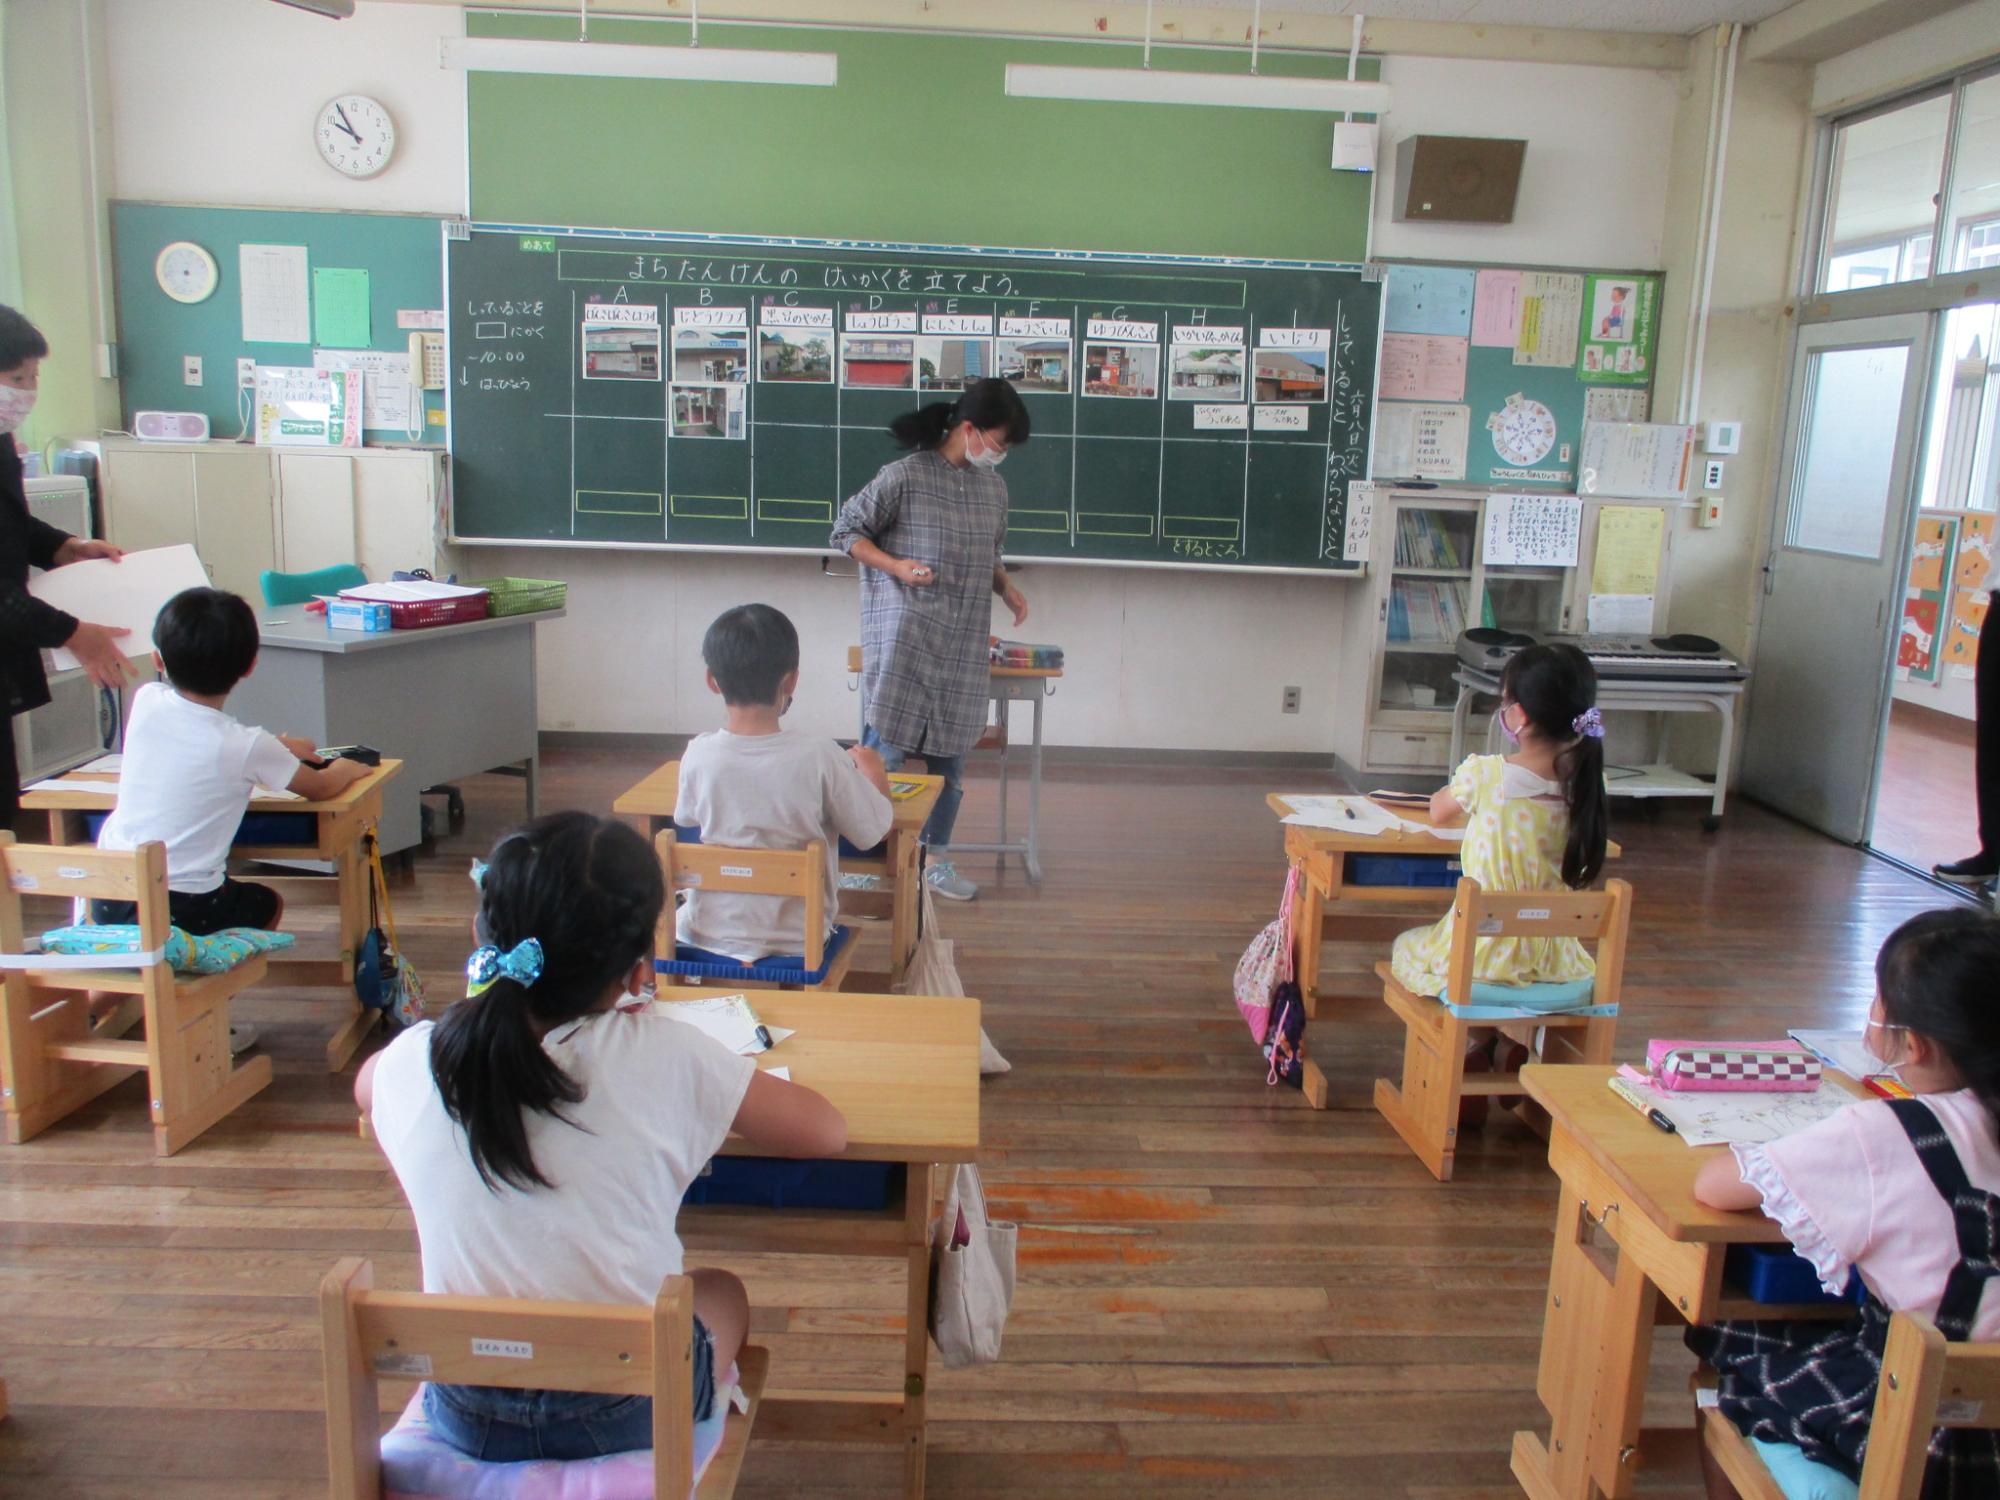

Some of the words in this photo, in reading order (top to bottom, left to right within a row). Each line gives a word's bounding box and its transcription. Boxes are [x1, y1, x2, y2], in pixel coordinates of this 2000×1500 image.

[350, 102, 358, 112] 12
[327, 116, 336, 125] 10
[376, 118, 380, 128] 2
[324, 130, 330, 138] 9
[381, 132, 386, 142] 3
[328, 144, 336, 153] 8
[376, 146, 382, 156] 4
[340, 154, 345, 164] 7
[352, 160, 359, 168] 6
[366, 156, 372, 166] 5
[523, 240, 551, 251] めあて
[629, 255, 798, 284] まちたんけんの
[613, 285, 629, 304] A
[700, 288, 713, 306] B
[784, 291, 799, 307] C
[870, 295, 883, 311] D
[946, 298, 959, 314] E
[1028, 301, 1041, 318] F
[852, 313, 912, 329] しょうぼうこ
[1111, 305, 1128, 323] G
[1191, 308, 1206, 326] H
[511, 326, 544, 340] にかく
[480, 377, 531, 391] はっぴょう
[1324, 450, 1346, 560] わからないこと
